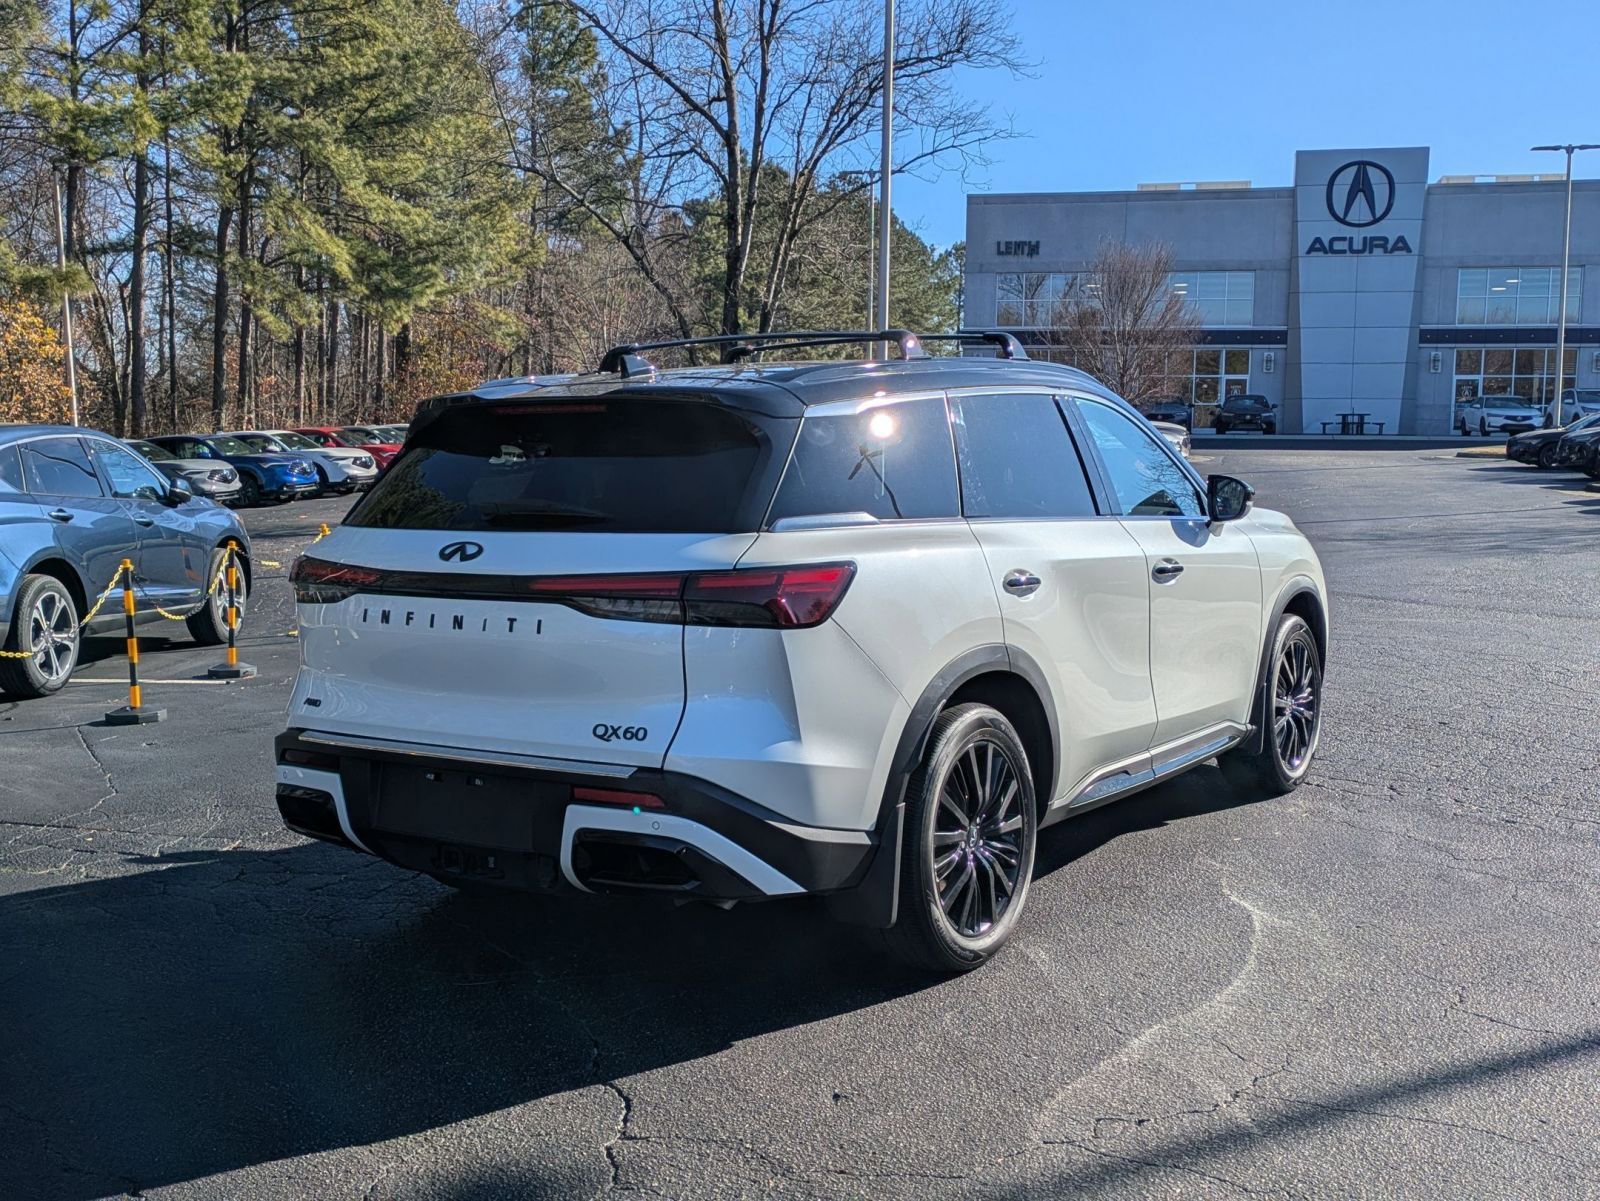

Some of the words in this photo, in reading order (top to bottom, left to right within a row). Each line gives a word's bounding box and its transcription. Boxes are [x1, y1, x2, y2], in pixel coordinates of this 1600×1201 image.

[996, 240, 1040, 257] LEITH
[1305, 235, 1412, 255] ACURA
[362, 608, 542, 635] INFINITI
[592, 723, 648, 742] QX60
